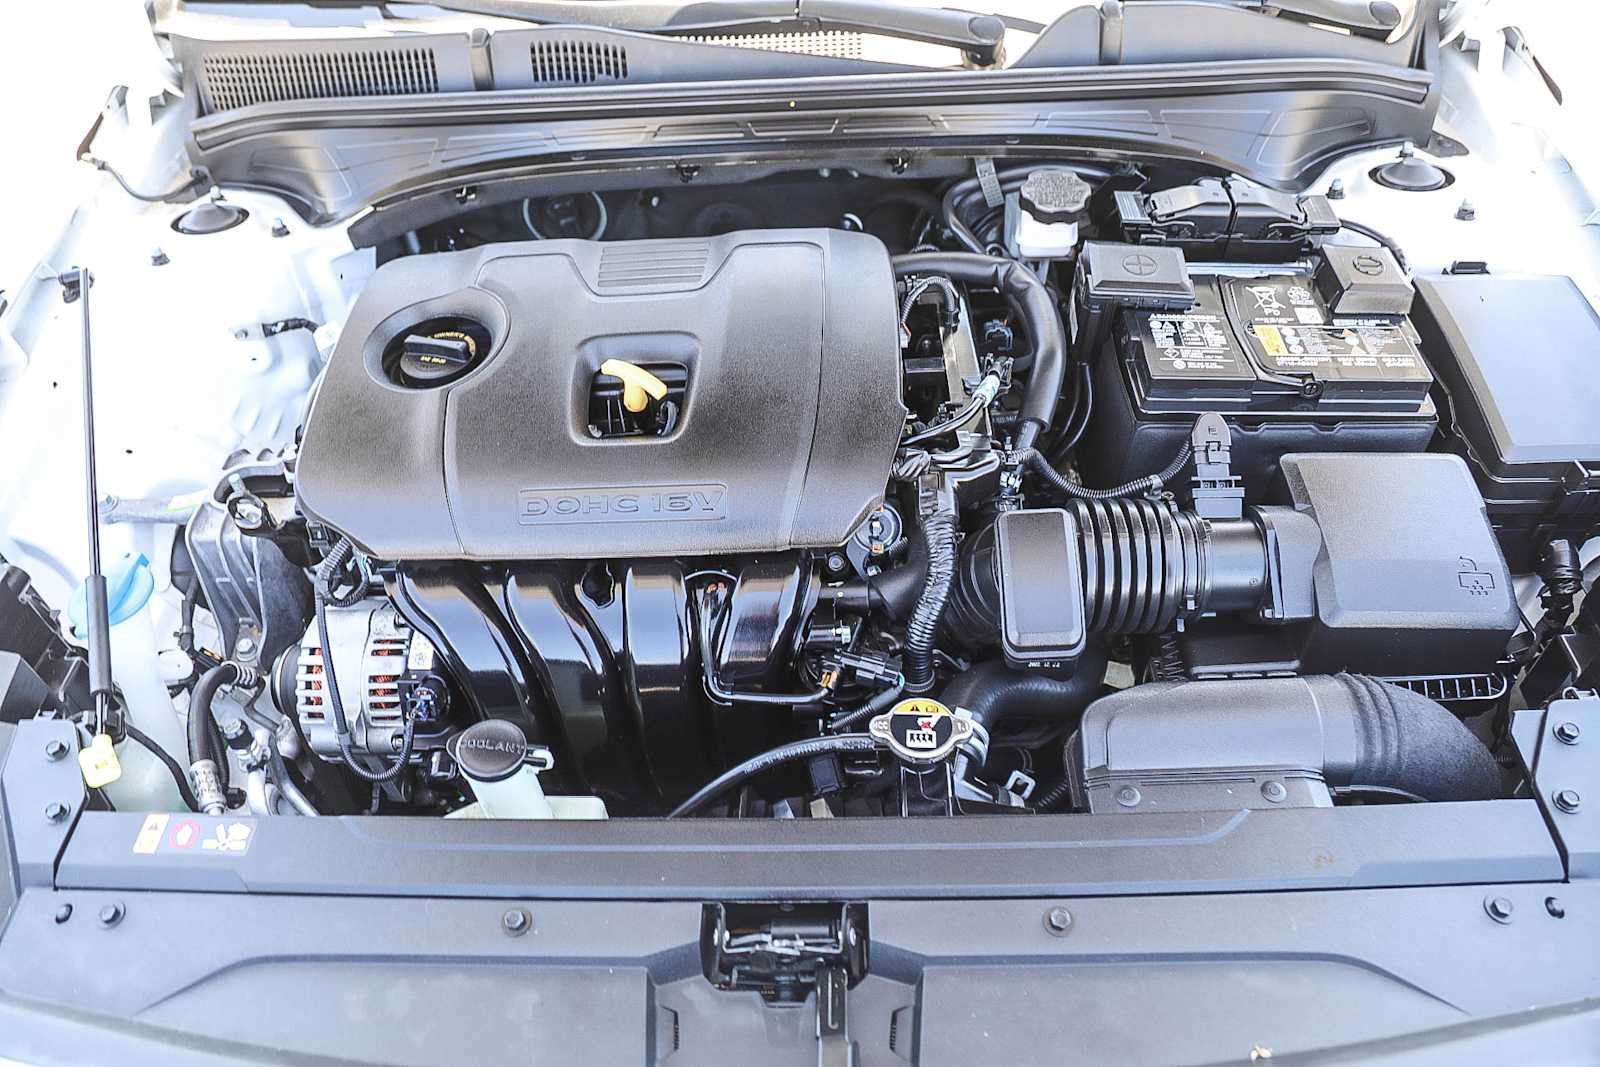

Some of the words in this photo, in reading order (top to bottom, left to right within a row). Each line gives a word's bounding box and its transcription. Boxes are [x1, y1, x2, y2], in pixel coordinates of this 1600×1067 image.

[1263, 308, 1281, 316] Pb
[520, 495, 640, 517] DOHC
[651, 491, 724, 513] 16V
[461, 738, 525, 754] COOLANT
